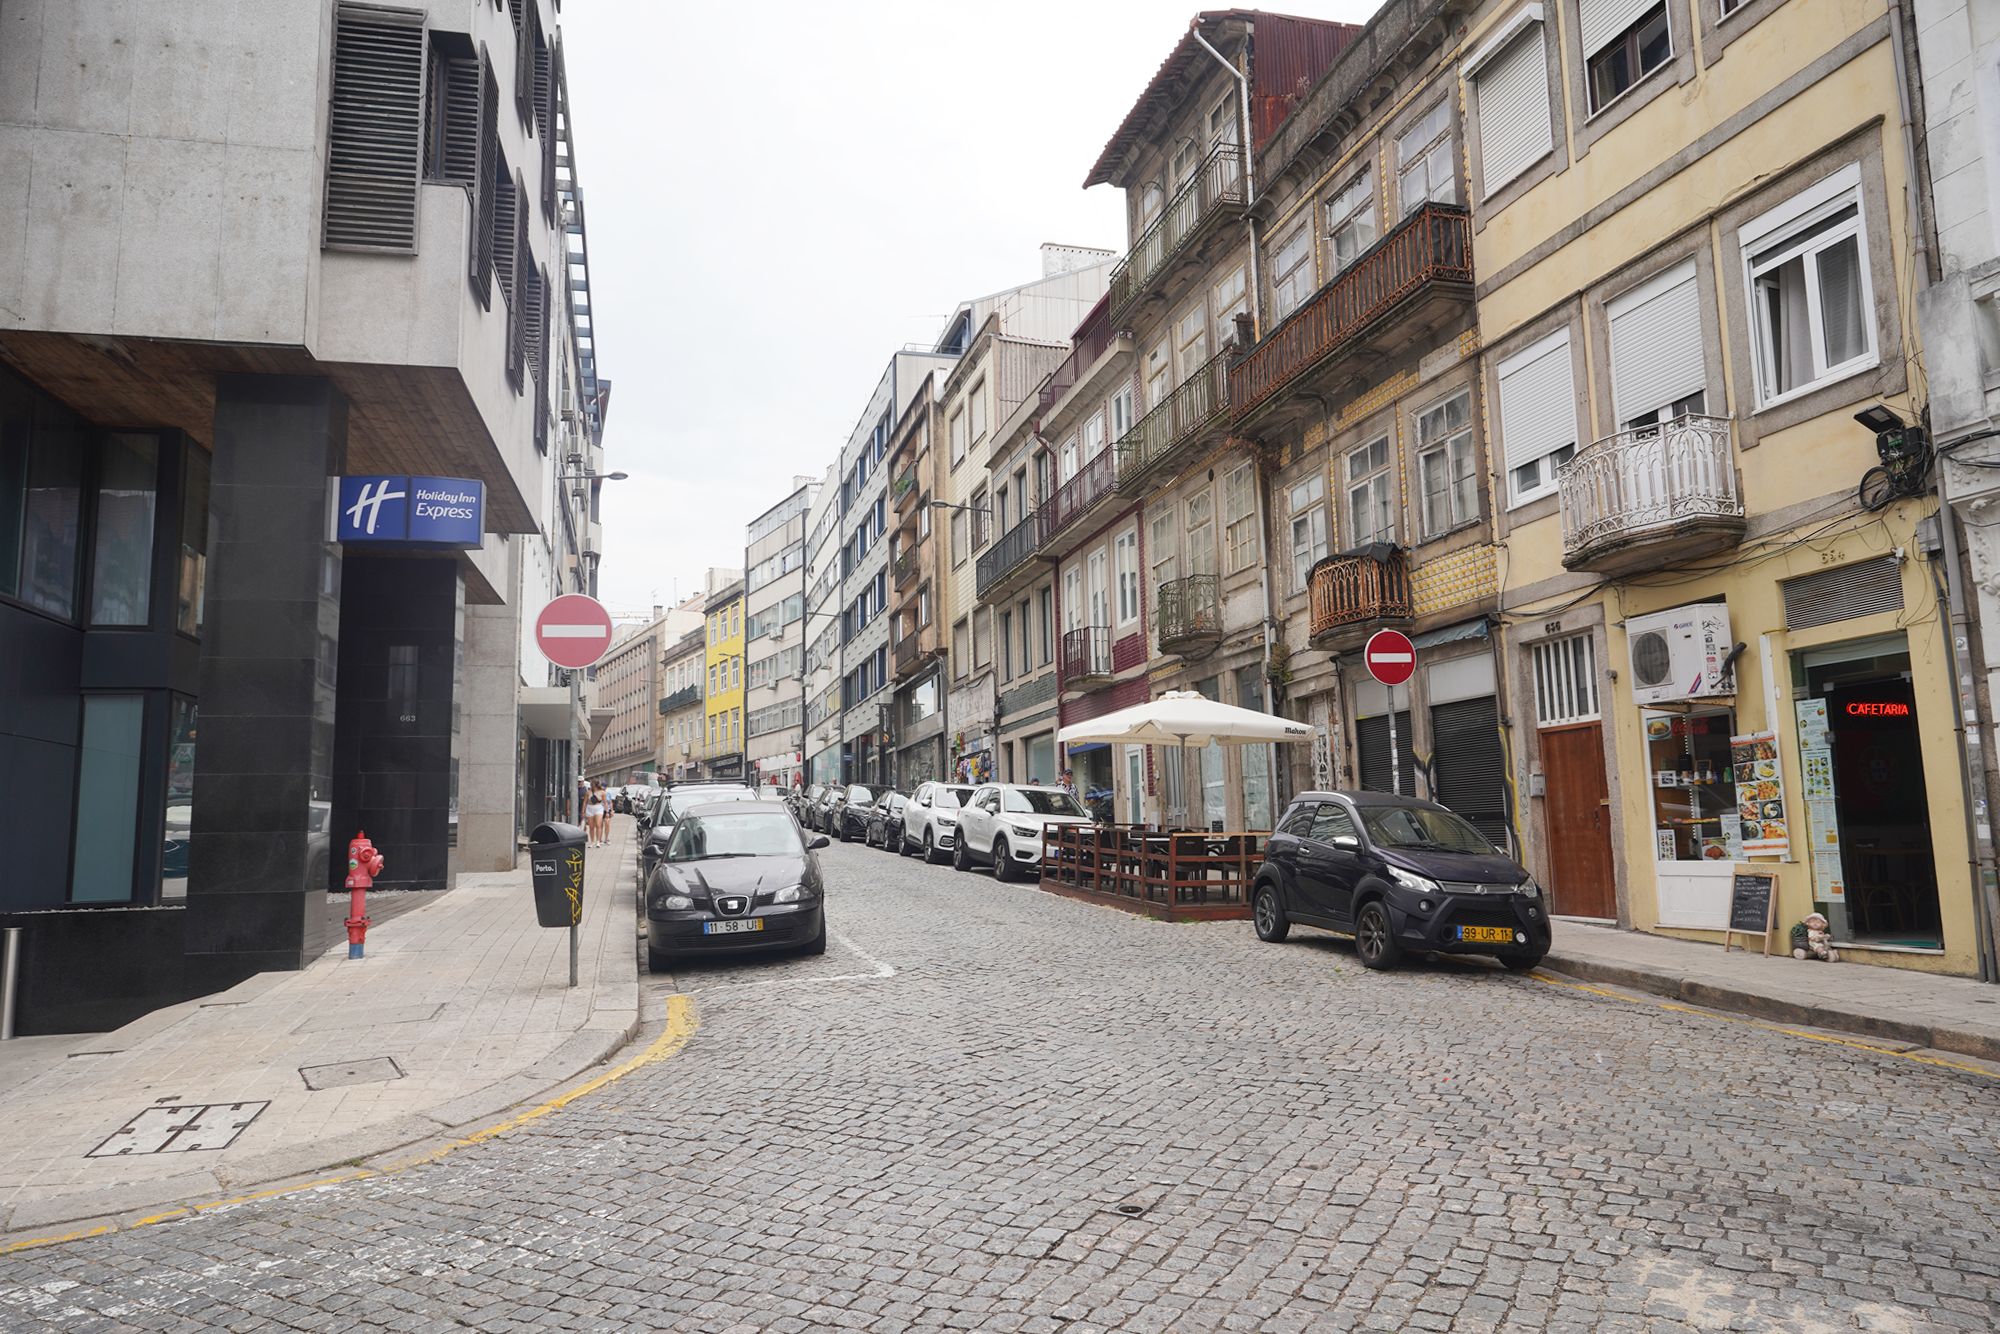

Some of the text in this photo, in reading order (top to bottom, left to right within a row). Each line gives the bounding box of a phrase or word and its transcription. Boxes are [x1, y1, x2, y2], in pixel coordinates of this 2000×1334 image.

[416, 489, 476, 504] Holiday Inn
[416, 503, 473, 520] Express
[1847, 703, 1909, 716] CAFETARIA
